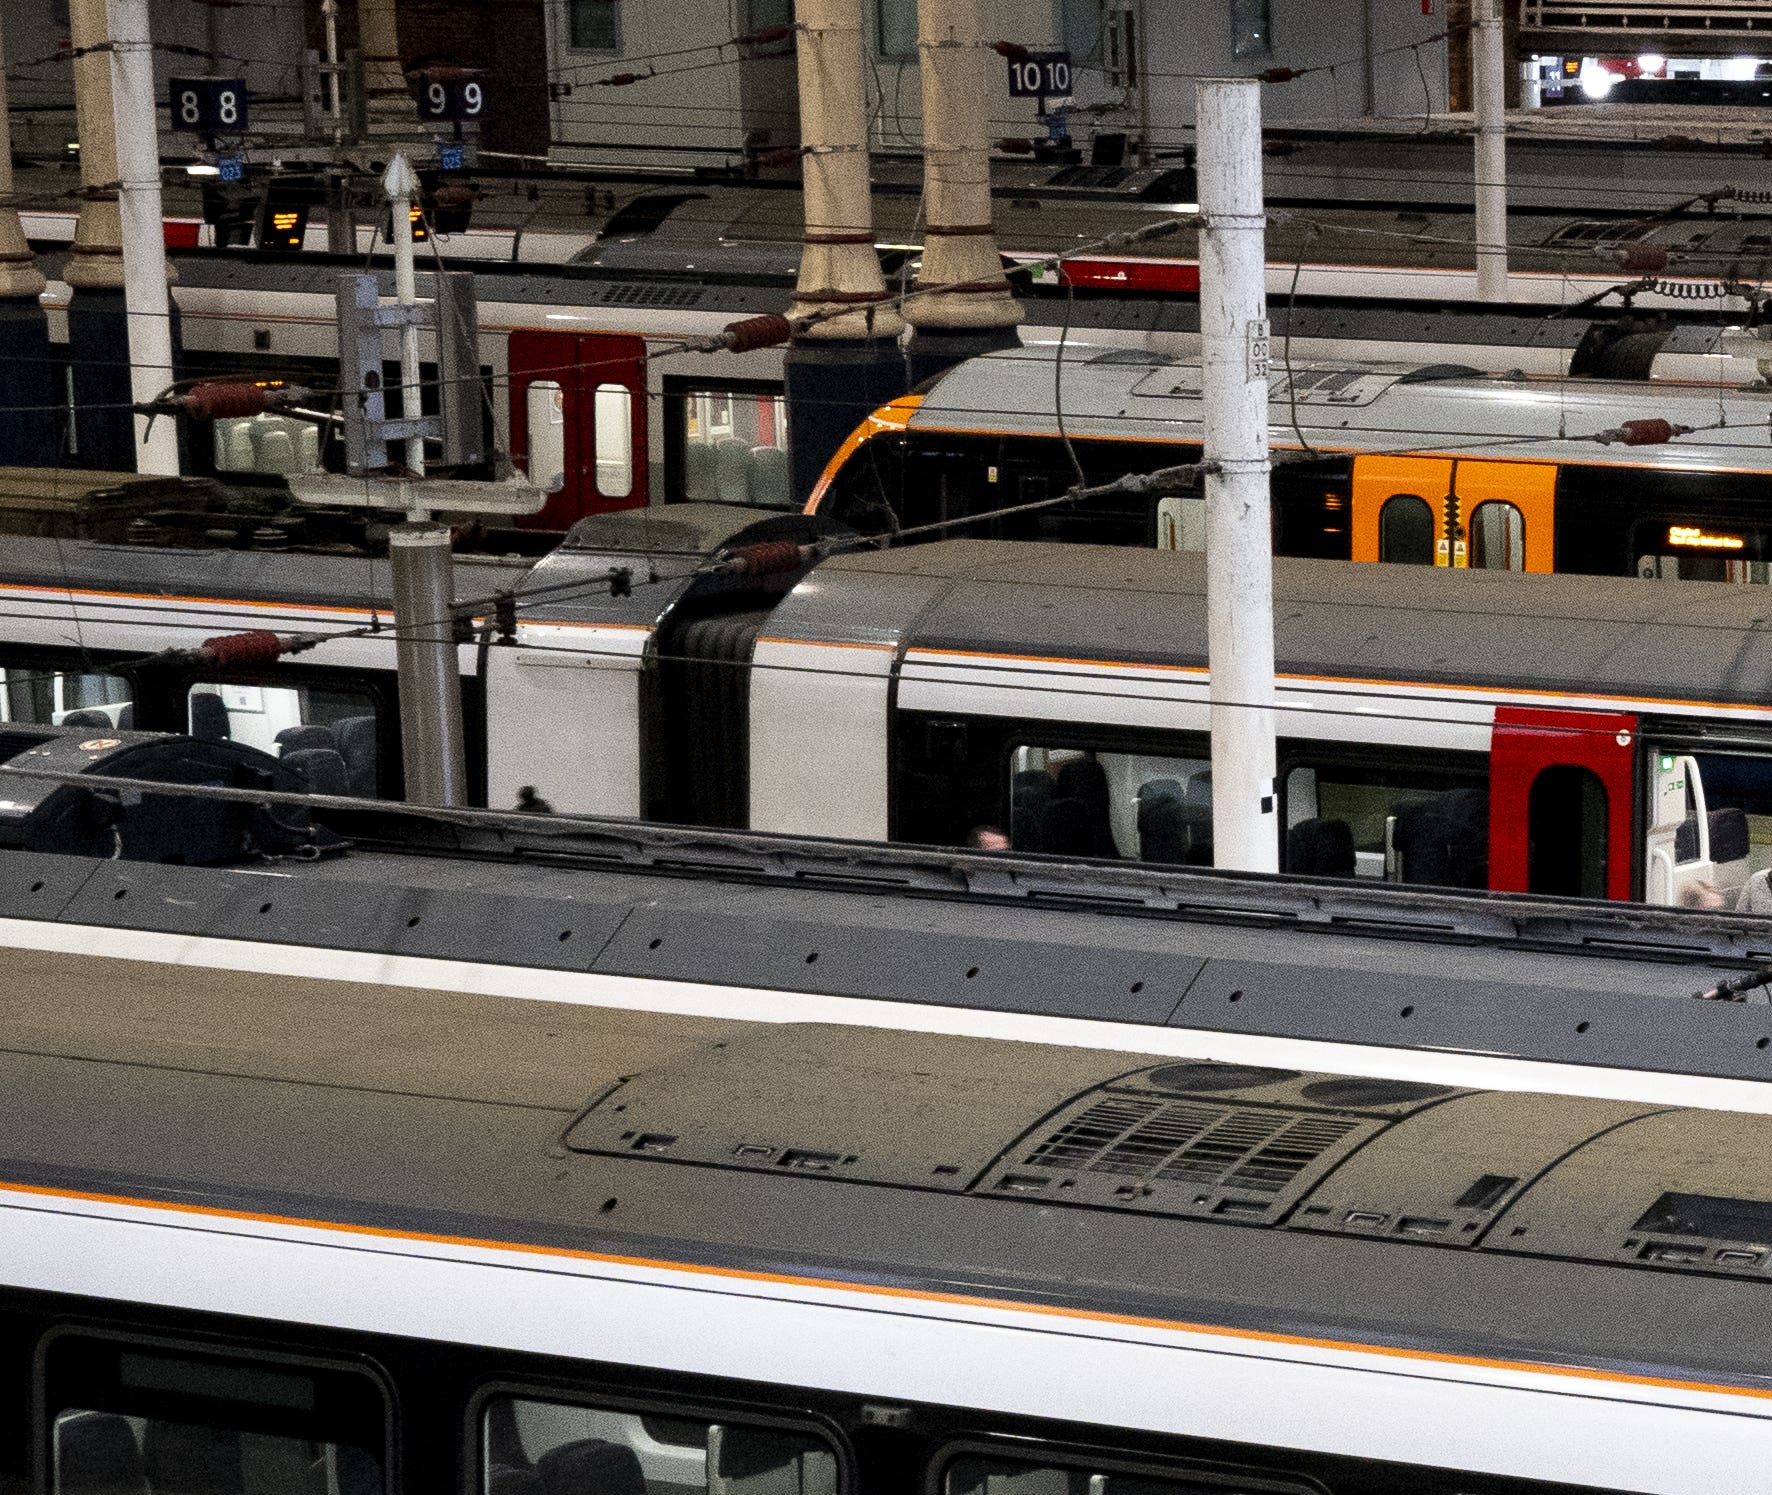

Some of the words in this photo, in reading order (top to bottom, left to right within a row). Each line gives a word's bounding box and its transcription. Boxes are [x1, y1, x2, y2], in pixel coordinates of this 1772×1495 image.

[1011, 62, 1041, 91] 10
[1046, 62, 1069, 90] 10
[181, 90, 200, 124] 8
[219, 90, 237, 124] 8
[428, 83, 446, 114] 9
[464, 82, 483, 114] 9
[1254, 364, 1267, 377] 32
